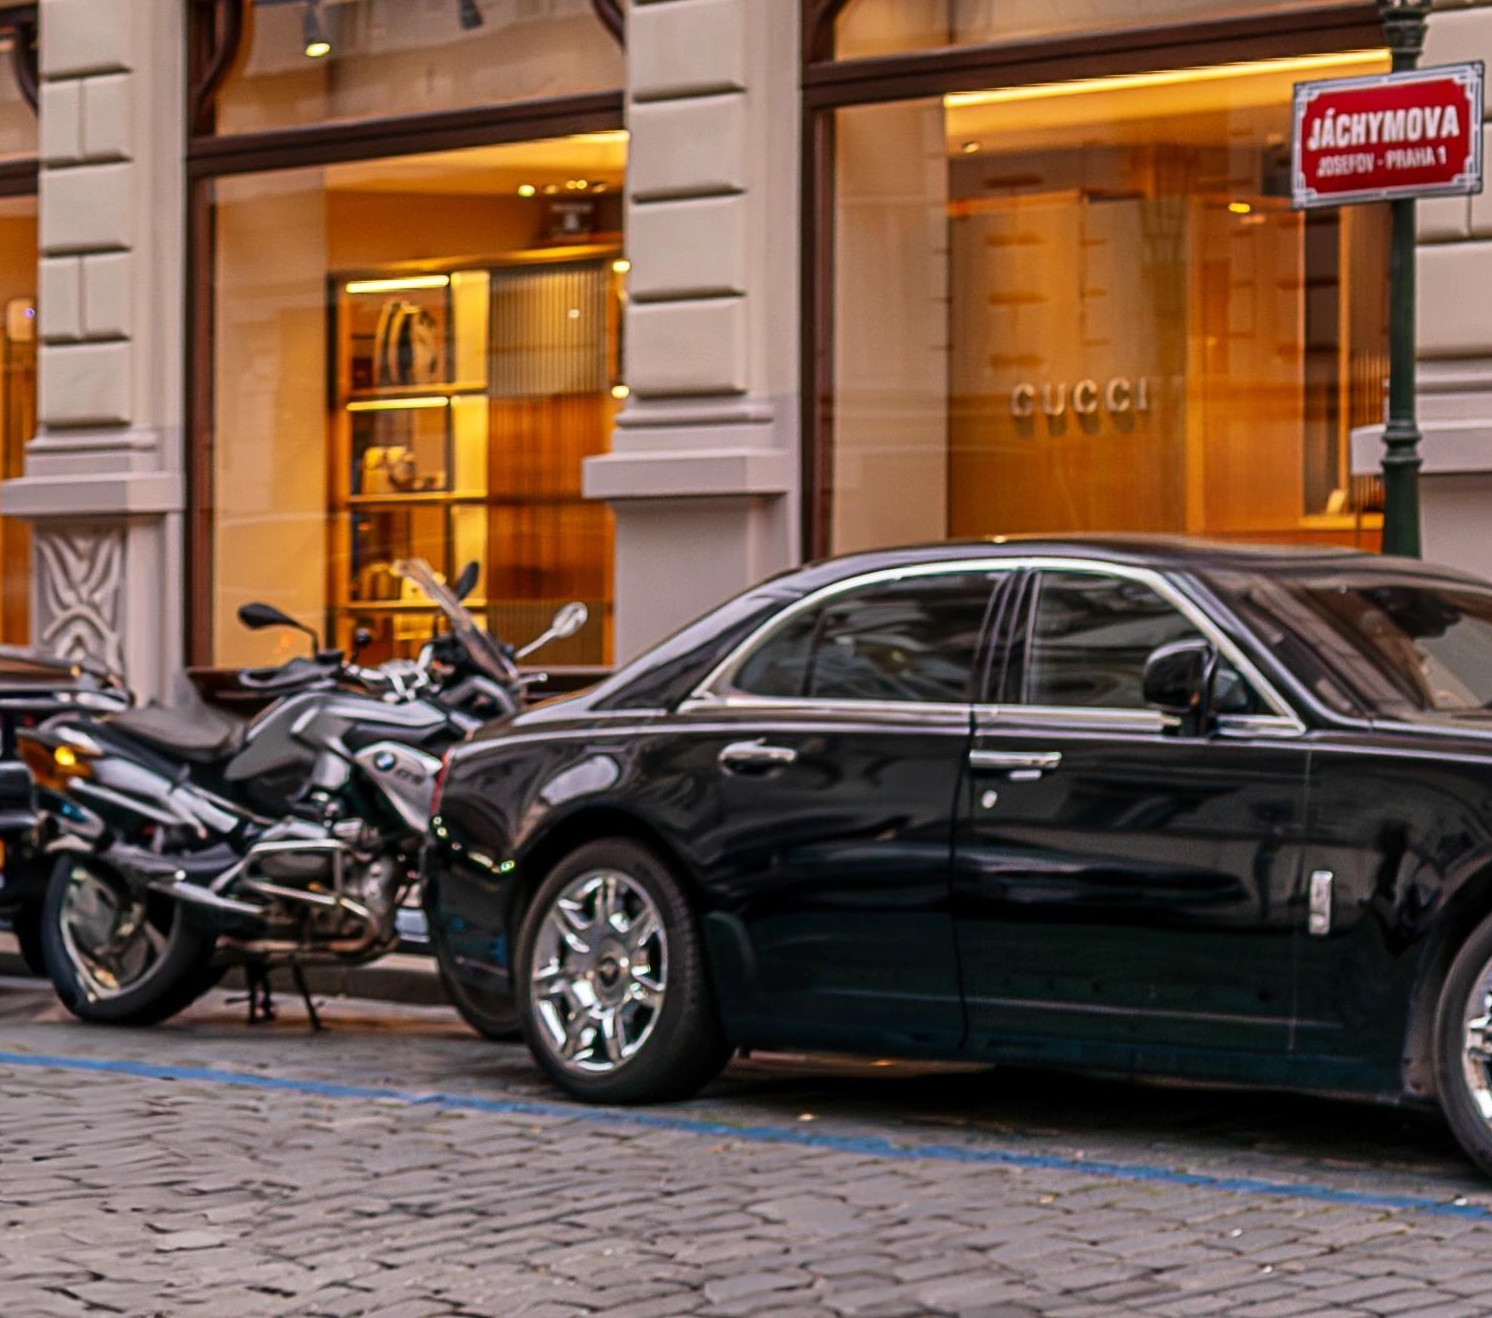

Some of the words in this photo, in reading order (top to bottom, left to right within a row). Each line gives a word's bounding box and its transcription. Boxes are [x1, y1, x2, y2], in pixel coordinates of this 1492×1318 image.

[1307, 104, 1461, 151] JÁCHYMOVA
[1317, 153, 1375, 178] JOSEFOV
[1385, 148, 1436, 171] PRAHA
[1436, 145, 1447, 165] 1
[1010, 375, 1150, 419] GUCCI
